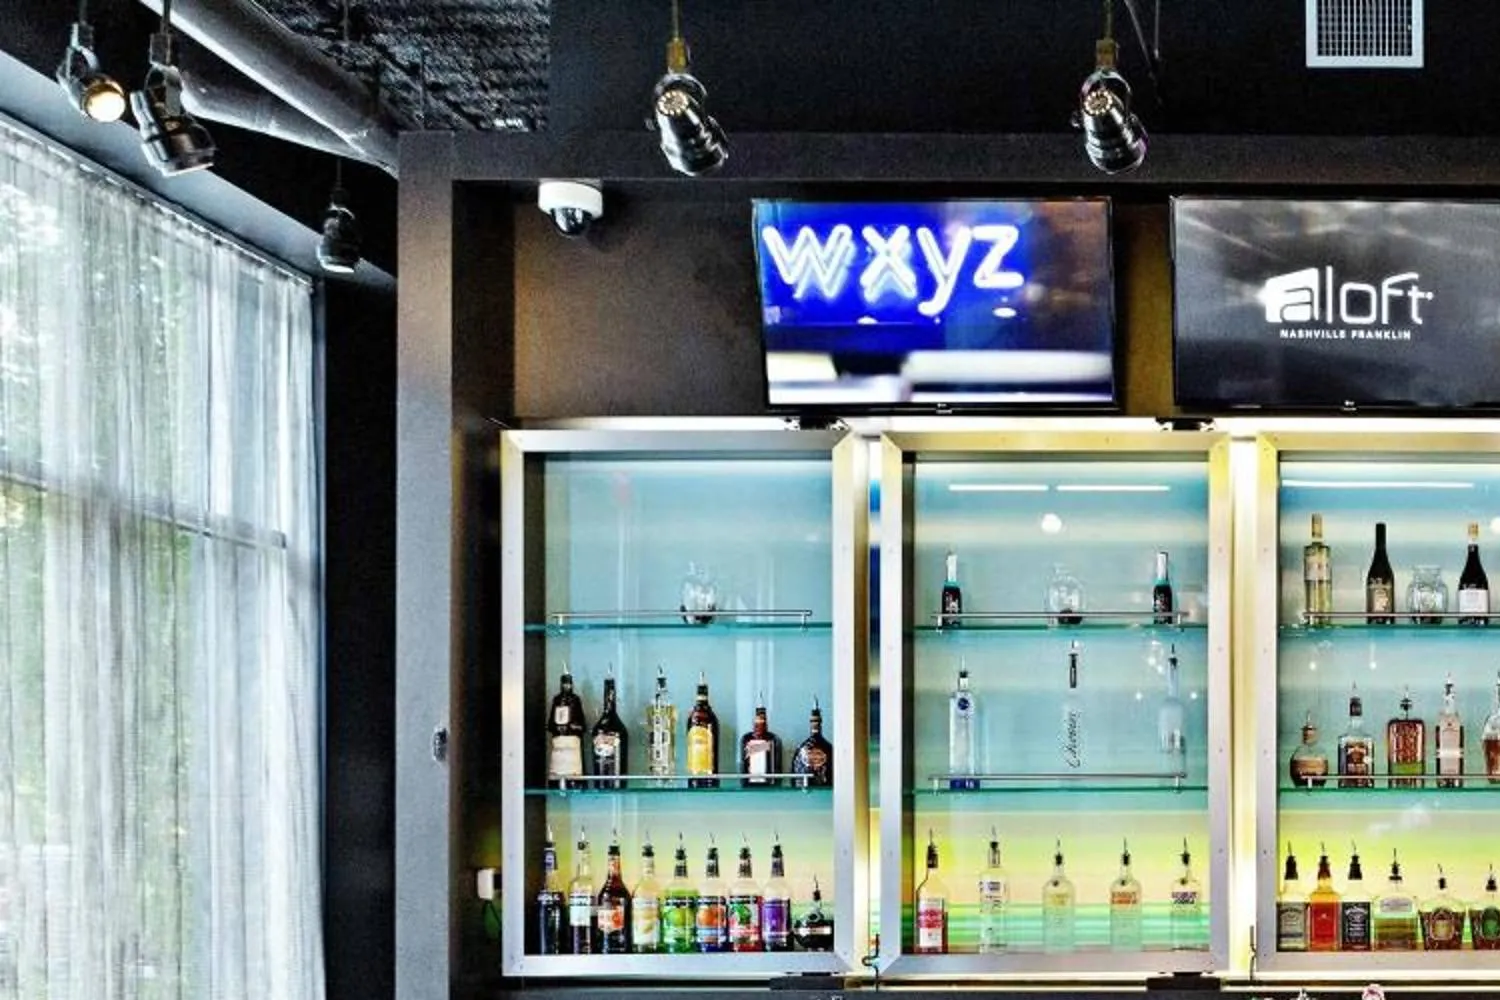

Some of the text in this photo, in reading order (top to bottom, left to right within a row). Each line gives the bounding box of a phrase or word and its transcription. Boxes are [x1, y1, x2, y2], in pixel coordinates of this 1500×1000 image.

[762, 224, 1024, 316] wxyz
[1265, 265, 1434, 324] aloft
[1280, 329, 1411, 340] NASHVILLE FRANKLIN
